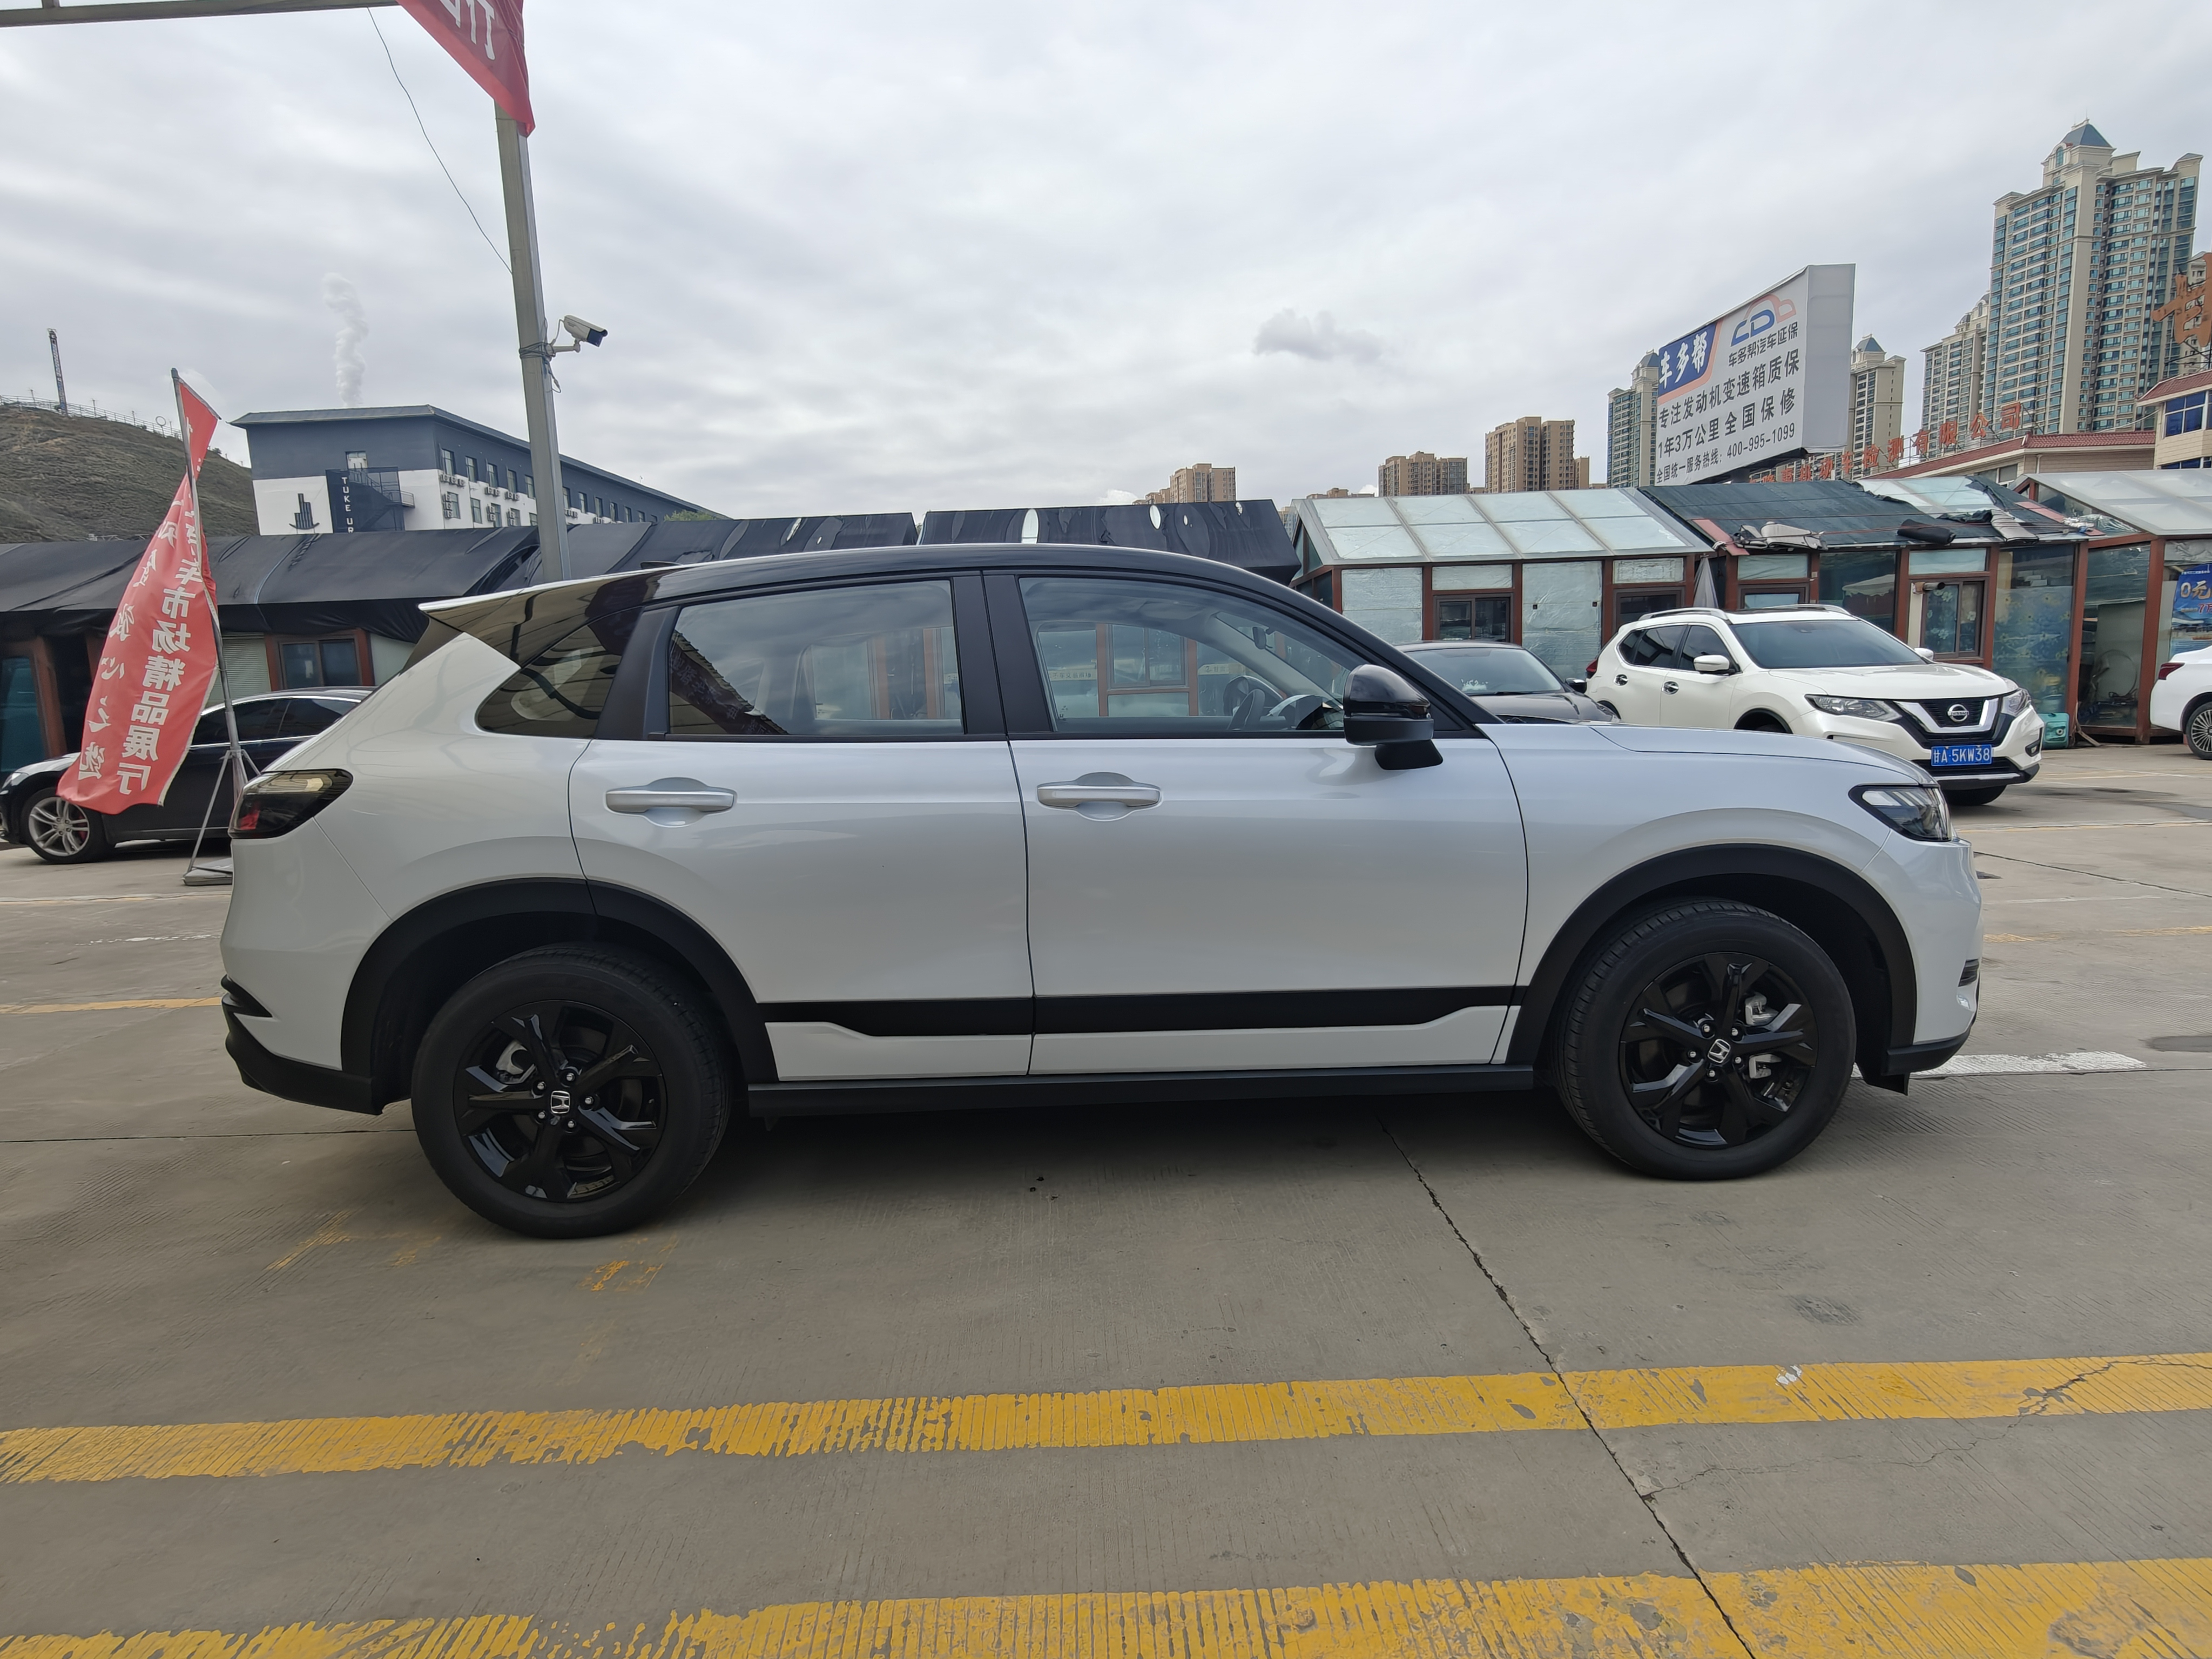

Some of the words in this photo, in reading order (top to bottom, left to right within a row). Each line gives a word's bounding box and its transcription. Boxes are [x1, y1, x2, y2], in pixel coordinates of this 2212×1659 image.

[1658, 331, 1708, 389] 车多帮
[1728, 321, 1798, 367] 车多帮汽车延保
[1658, 348, 1800, 429] 专注发动机变速箱质保
[341, 477, 351, 511] TUKE
